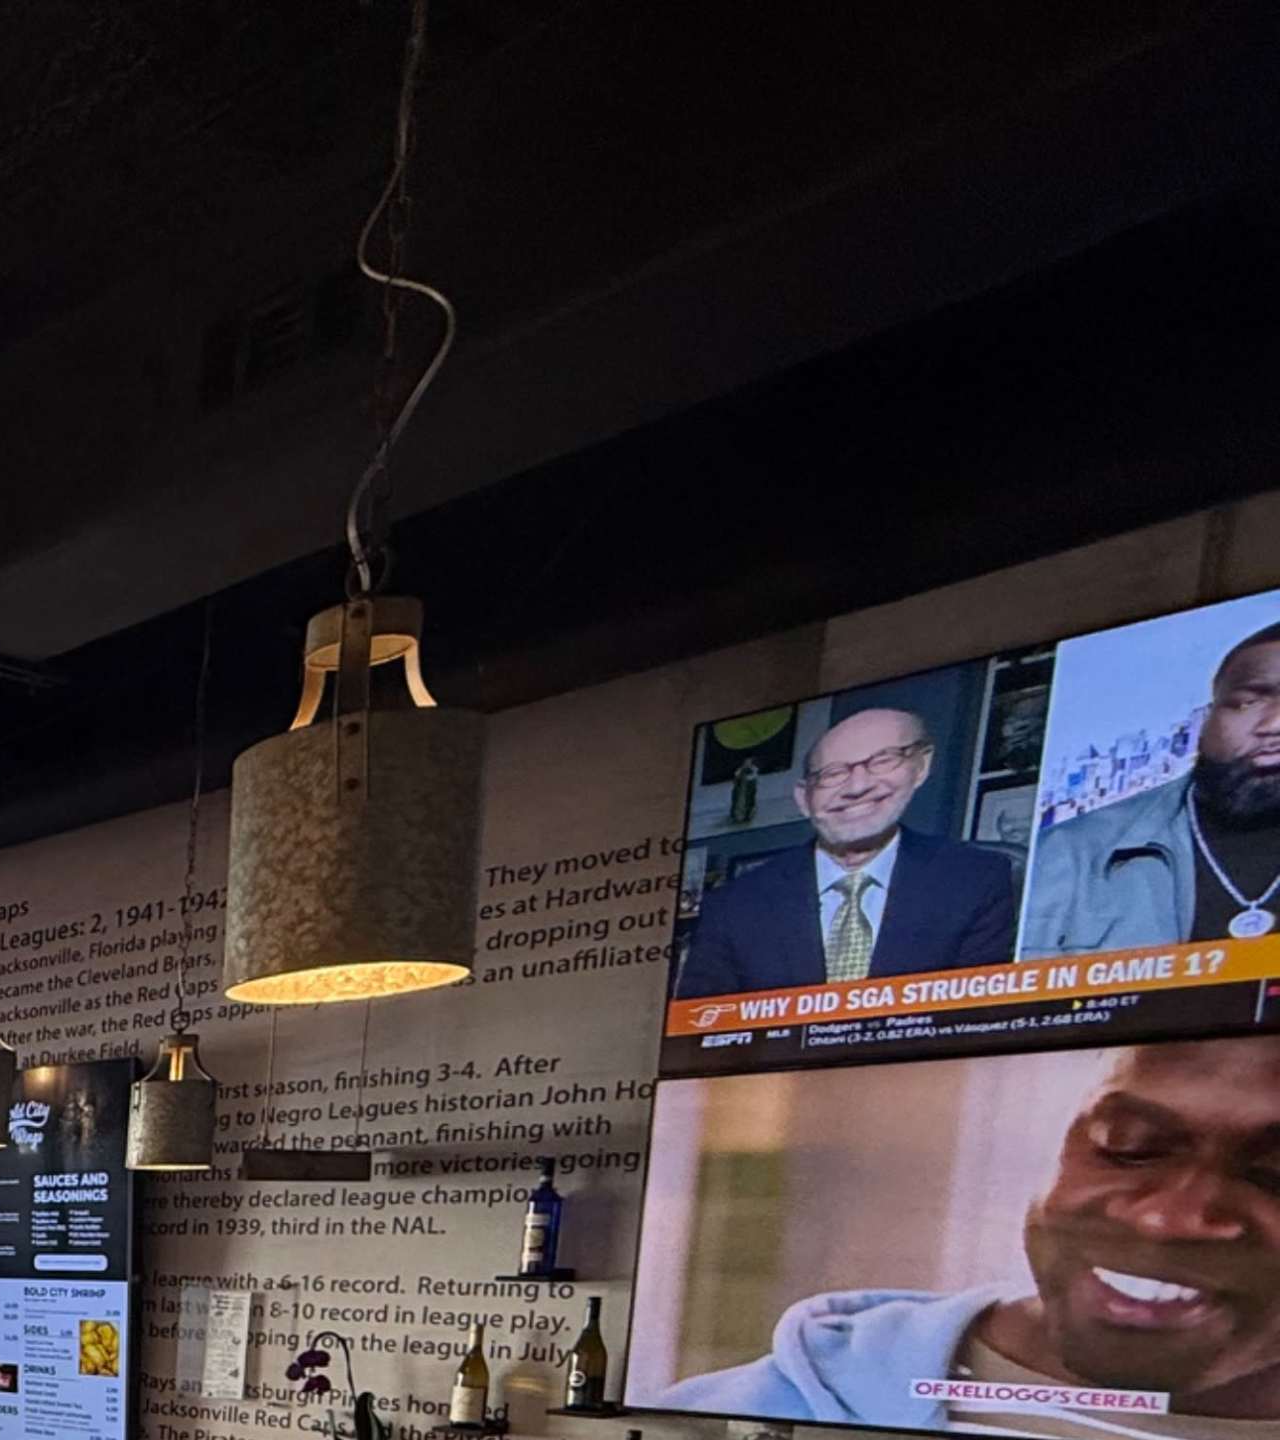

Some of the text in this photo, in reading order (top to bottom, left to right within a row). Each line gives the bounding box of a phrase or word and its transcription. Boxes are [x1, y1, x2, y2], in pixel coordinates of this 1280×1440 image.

[485, 837, 651, 888] They moved
[512, 872, 681, 916] at Hardware
[0, 920, 86, 951] Leagues:
[89, 914, 109, 938] 2,
[88, 934, 146, 960] Florida
[150, 923, 218, 952] playing
[486, 907, 668, 951] dropping out
[48, 971, 75, 991] the
[77, 961, 158, 987] Cleveland
[483, 963, 514, 983] an
[739, 948, 1227, 1021] WHY DID SGA STRUGGLE IN GAME 1?
[84, 993, 102, 1008] as
[106, 988, 133, 1007] the
[137, 982, 169, 1003] Red
[36, 1024, 61, 1043] the
[64, 1022, 97, 1041] war,
[101, 1016, 129, 1034] the
[132, 1009, 165, 1029] Red
[700, 1032, 753, 1049] ESPN
[808, 1016, 933, 1035] Dodgers Padres
[906, 1011, 1112, 1043] ERA) ERA)
[39, 1045, 95, 1065] Durkee
[99, 1038, 144, 1059] Field.
[254, 1055, 561, 1097] season, finishing 3-4. After
[236, 1083, 607, 1128] to Negro Leagues historian John
[292, 1114, 613, 1152] the pennant, finishing with
[374, 1148, 641, 1176] more going
[33, 1173, 79, 1188] SAUCES
[80, 1171, 109, 1187] AND
[33, 1188, 109, 1204] SEASONINGS
[173, 1186, 416, 1212] thereby declared league
[192, 1213, 447, 1237] in 1939, third in the NAL.
[23, 1286, 69, 1297] BOLD CITY
[216, 1273, 575, 1303] with a 6-16 record. Returning to
[270, 1301, 572, 1336] 8-10 record in league play.
[148, 1323, 512, 1360] before from the in
[23, 1363, 56, 1376] DRINKS
[140, 1373, 176, 1392] Rays
[914, 1382, 1160, 1409] OF KELLOGG'S CEREAL
[143, 1398, 250, 1425] Jacksonville
[254, 1410, 291, 1428] Red
